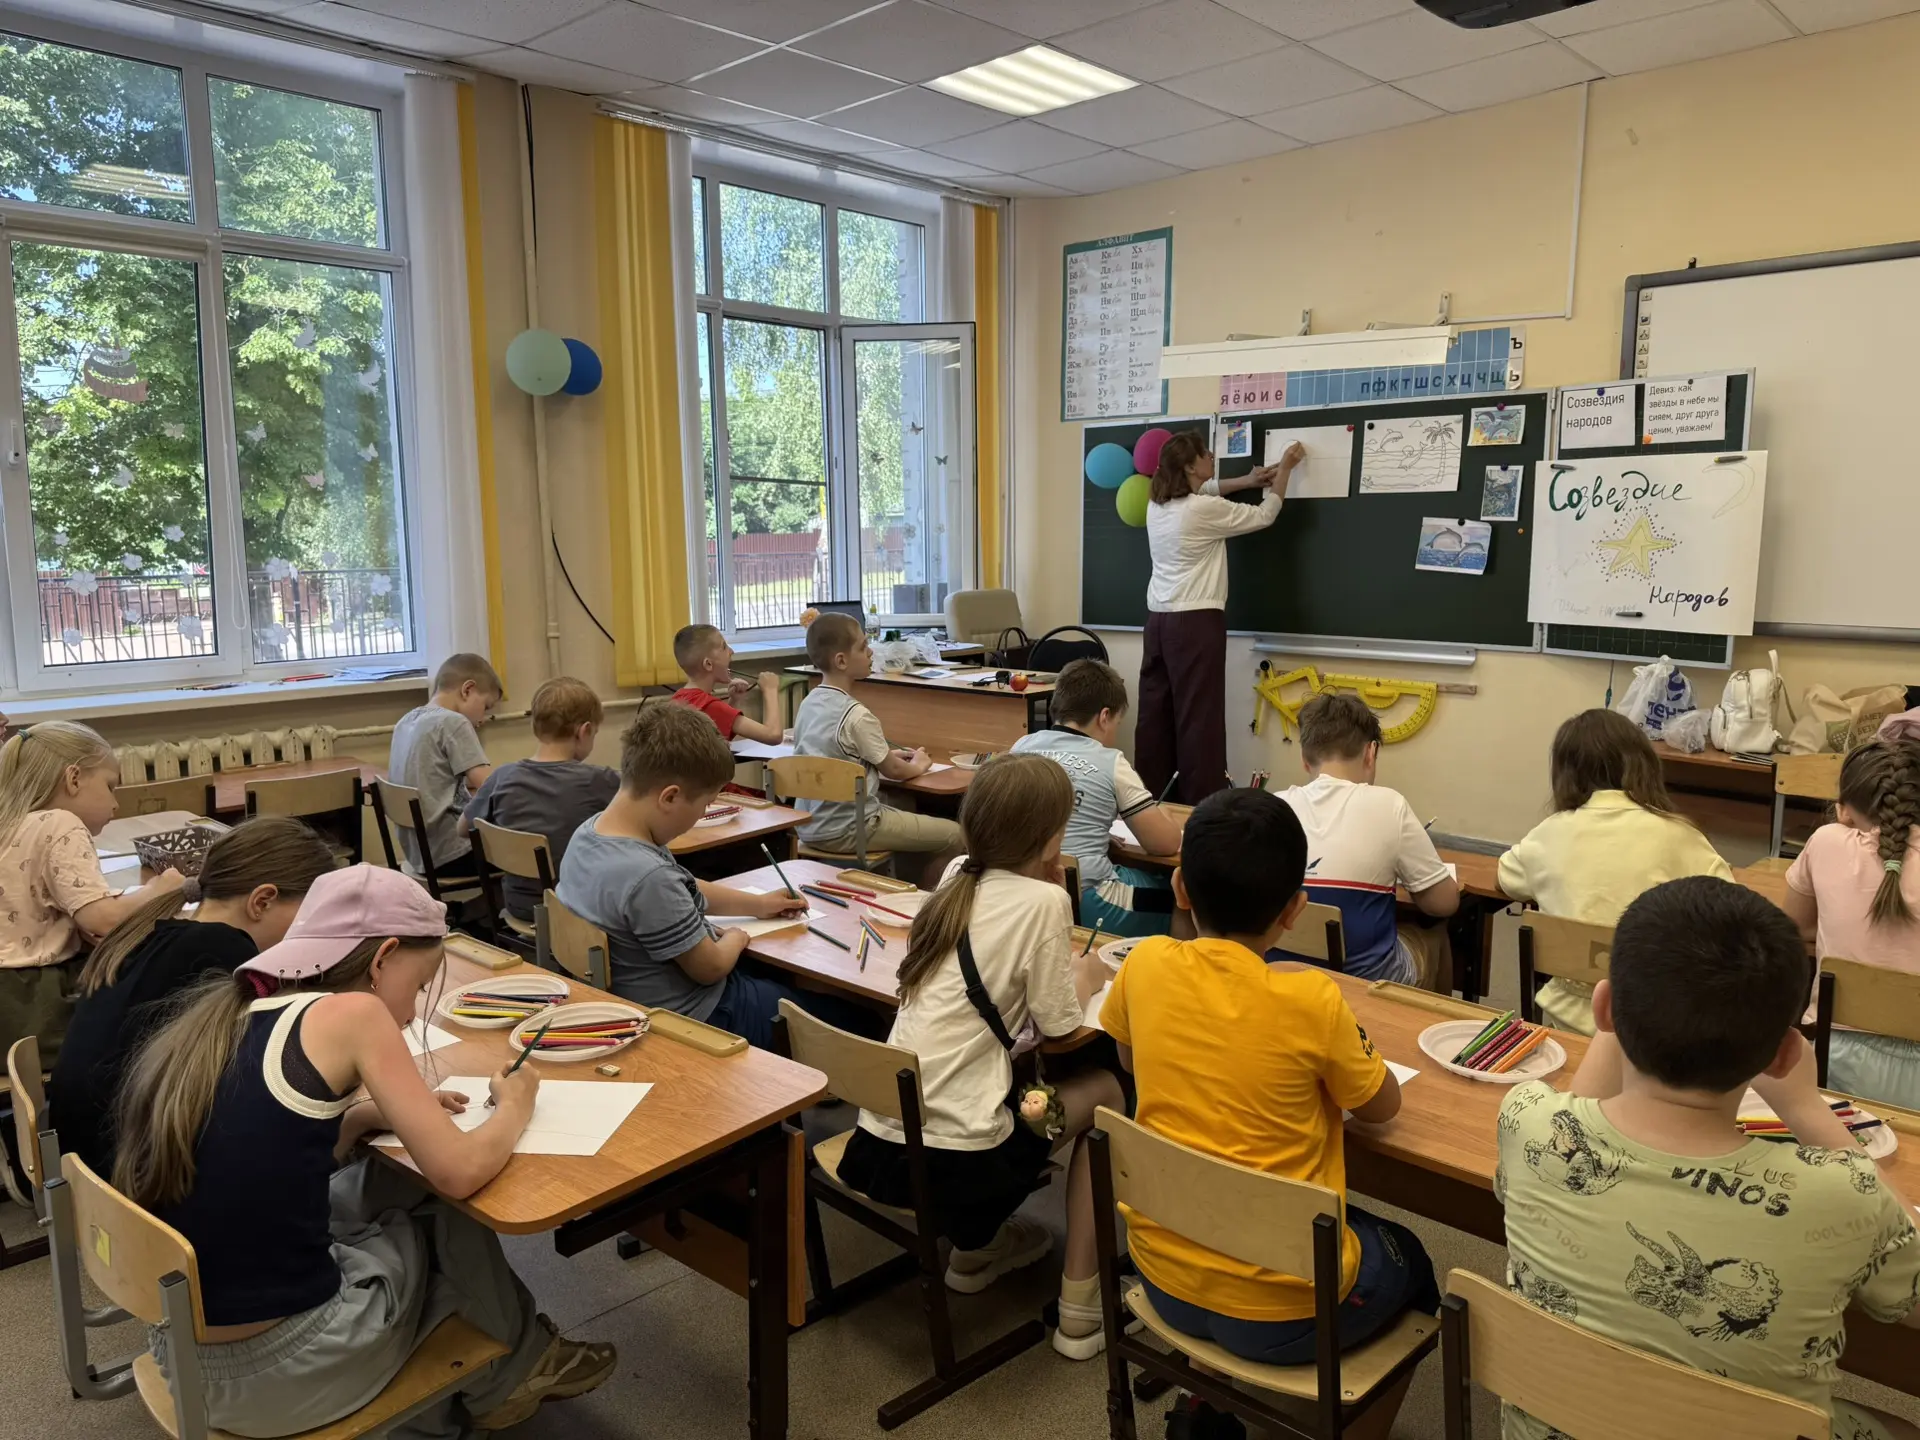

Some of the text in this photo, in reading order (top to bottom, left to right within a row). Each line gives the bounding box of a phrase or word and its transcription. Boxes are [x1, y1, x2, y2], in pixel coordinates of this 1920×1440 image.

[1649, 385, 1693, 396] Девиз: как
[1567, 393, 1625, 409] Созвездия
[1680, 398, 1685, 406] в
[1687, 395, 1706, 405] небе
[1566, 414, 1612, 430] народов
[1675, 410, 1694, 421] друг
[1696, 409, 1720, 420] друга
[1648, 423, 1713, 436] ценим, уважаем!
[1549, 469, 1692, 521] Созвездие
[1649, 587, 1729, 617] Народов
